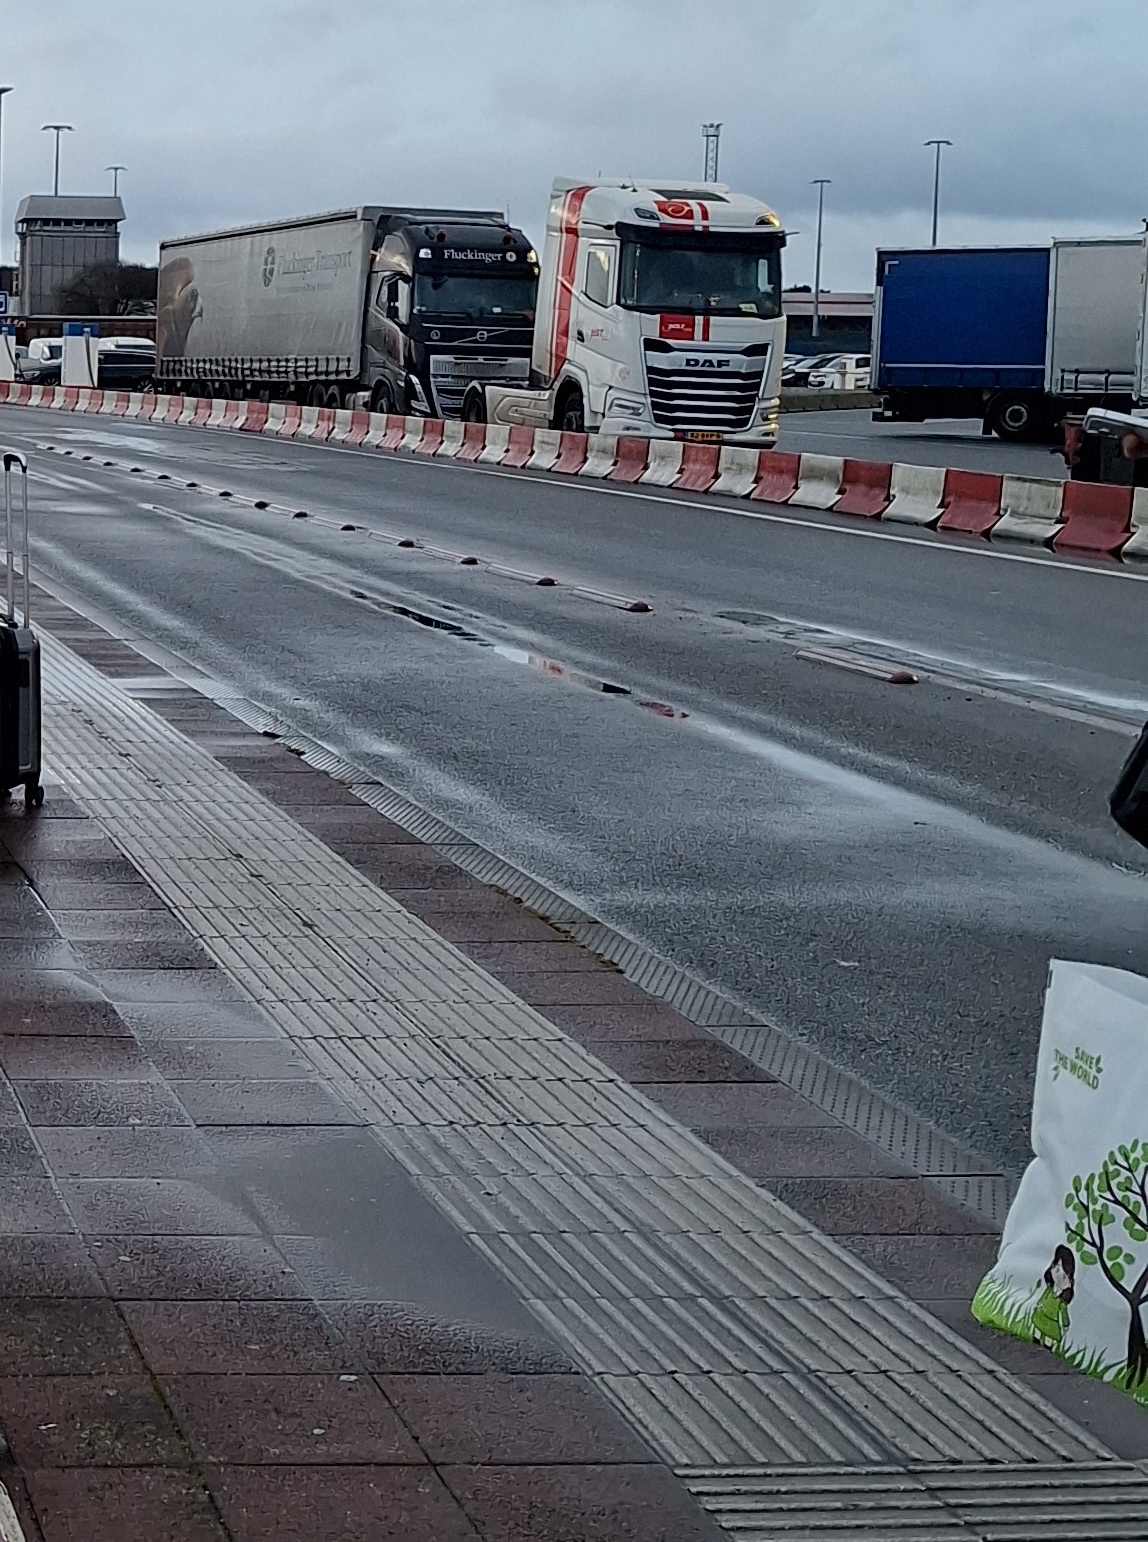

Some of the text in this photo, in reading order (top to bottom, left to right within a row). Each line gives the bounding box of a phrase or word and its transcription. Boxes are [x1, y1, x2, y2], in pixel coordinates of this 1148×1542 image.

[444, 248, 503, 264] Fluckinger
[685, 358, 731, 368] DAF
[1074, 1046, 1095, 1070] SAVE
[1054, 1048, 1099, 1090] THE WORLD
